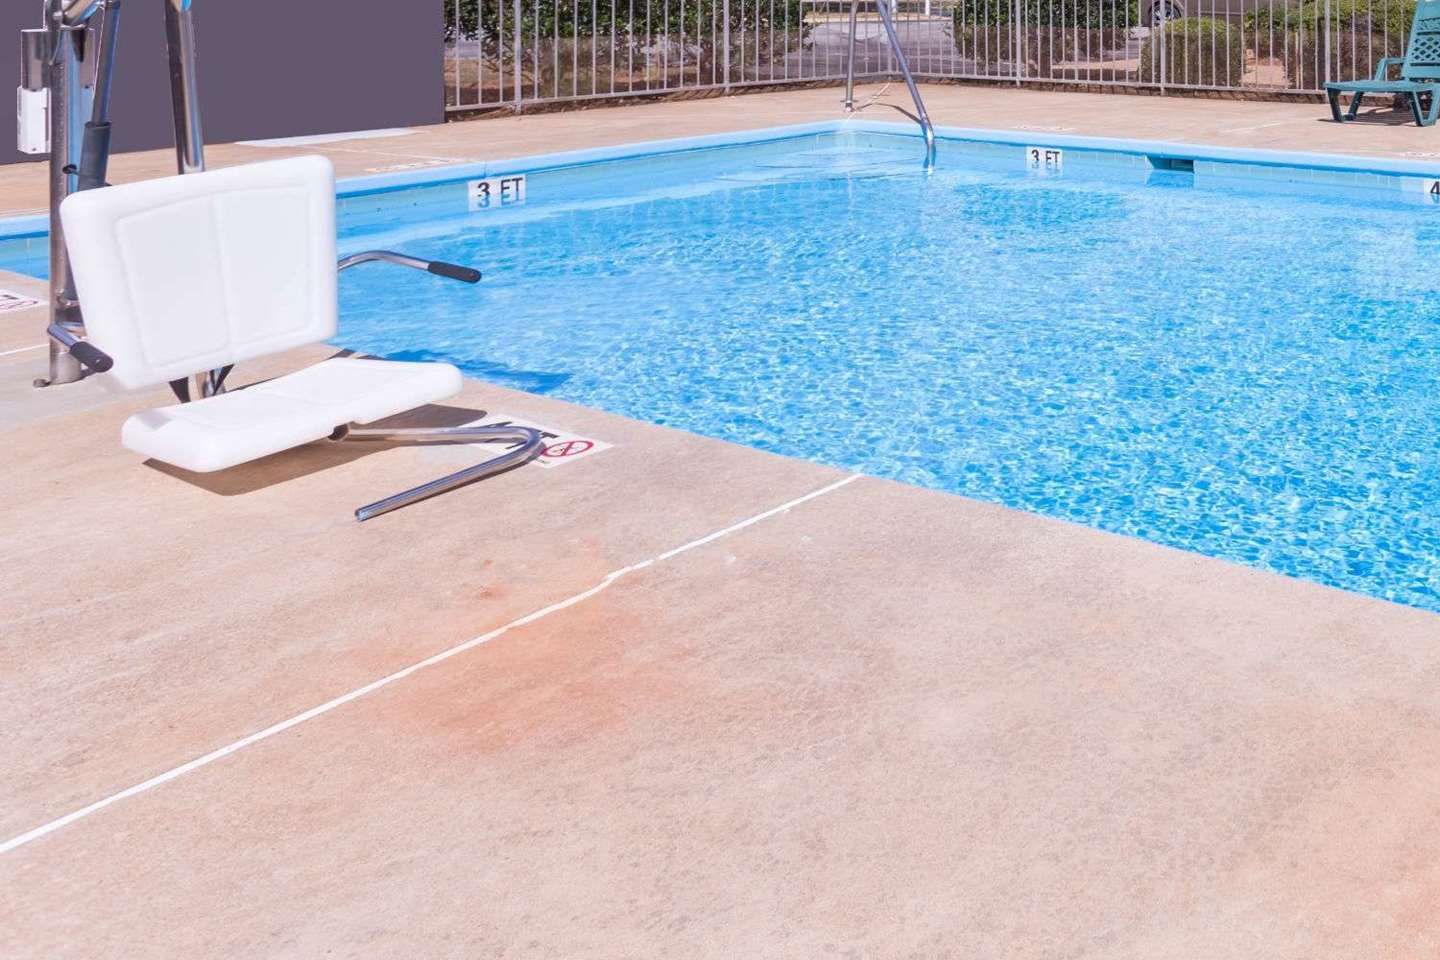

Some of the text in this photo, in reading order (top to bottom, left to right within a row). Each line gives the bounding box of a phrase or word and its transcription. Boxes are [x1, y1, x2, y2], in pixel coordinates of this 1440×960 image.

[1045, 150, 1061, 164] FT
[477, 177, 524, 199] 3 FT
